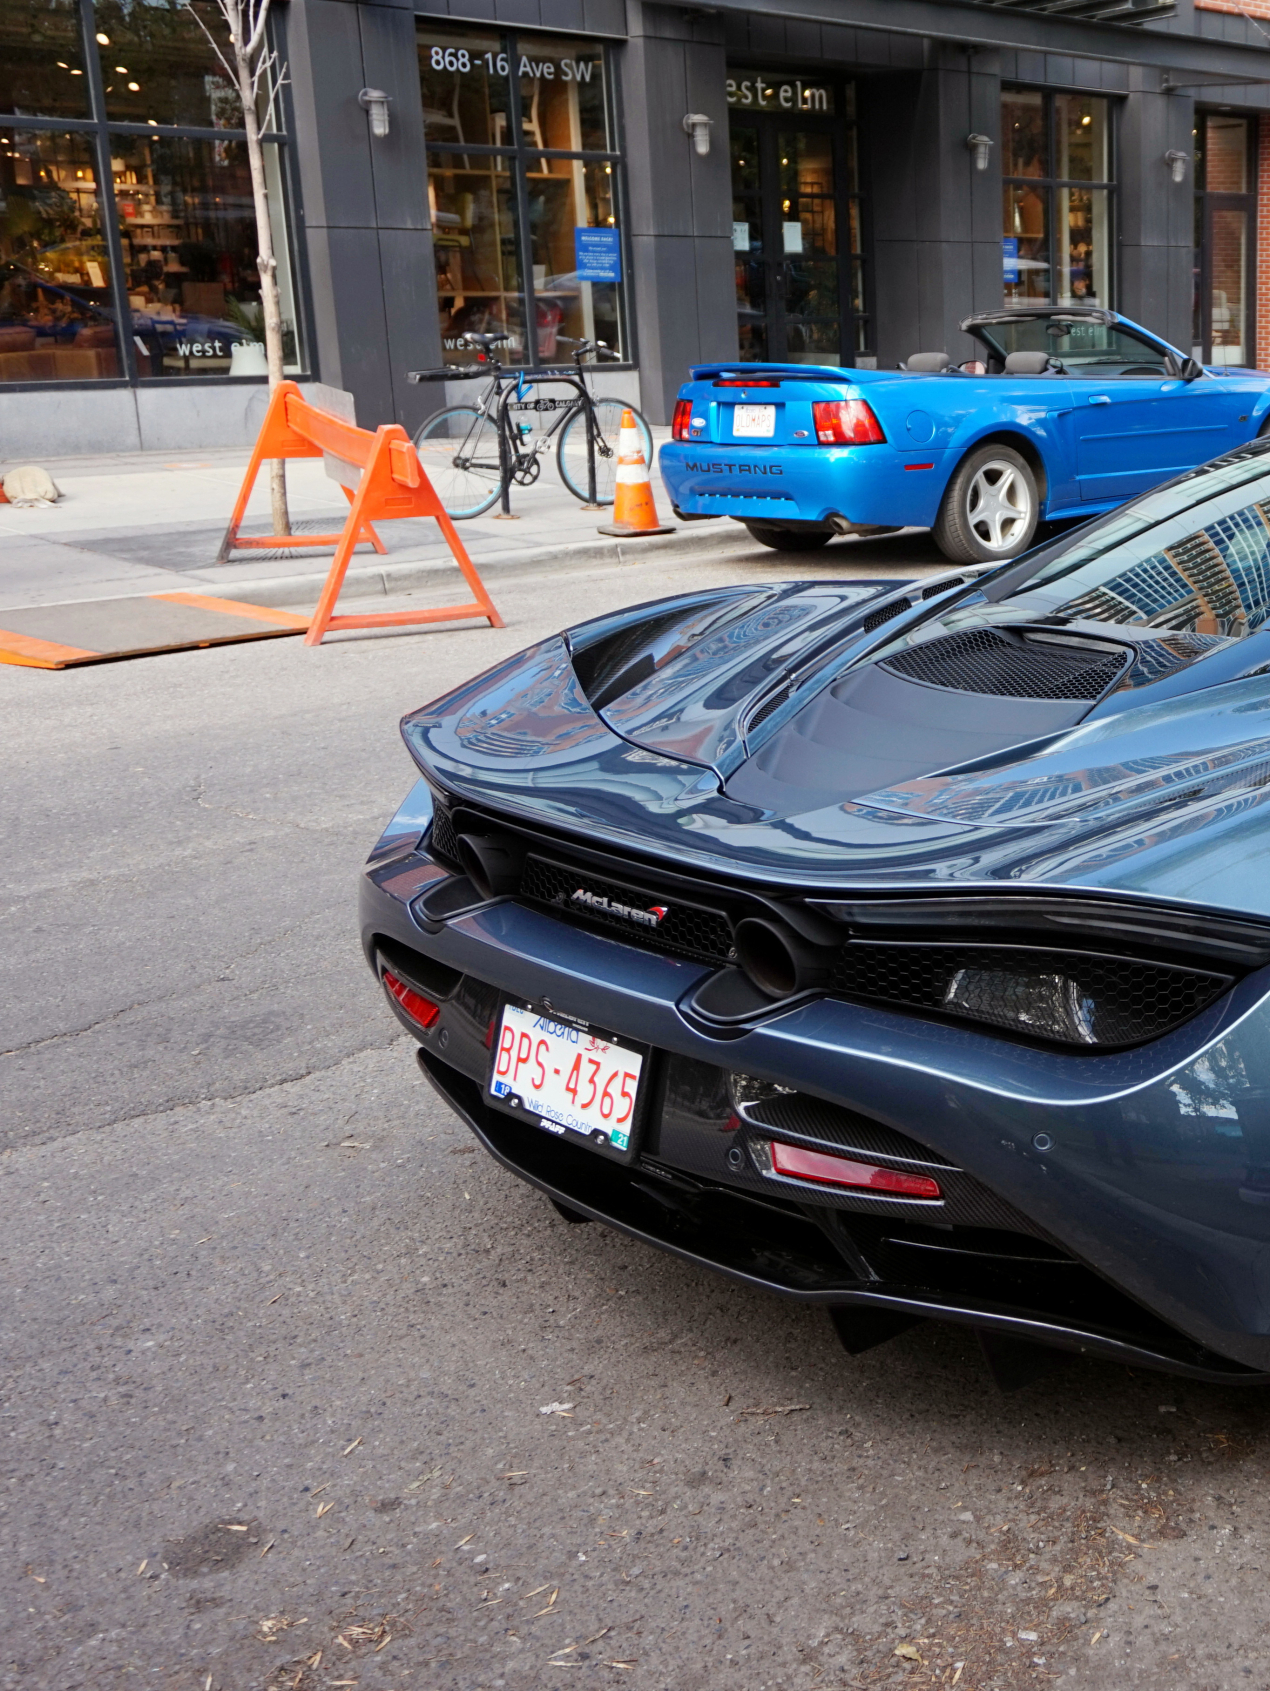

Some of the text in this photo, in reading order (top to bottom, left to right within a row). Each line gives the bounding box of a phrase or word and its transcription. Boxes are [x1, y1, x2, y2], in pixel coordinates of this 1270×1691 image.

[518, 55, 555, 80] Ave
[560, 58, 593, 83] SW
[726, 76, 827, 110] est elm
[176, 339, 224, 357] west
[735, 413, 772, 429] OLDMAPS
[685, 461, 784, 476] MUSTANG
[570, 888, 659, 928] McLaren
[496, 1024, 638, 1124] BPS-4365
[526, 1096, 544, 1114] Wild
[545, 1104, 565, 1122] Rose
[540, 1117, 567, 1135] PFAFF
[617, 1133, 628, 1147] 21
